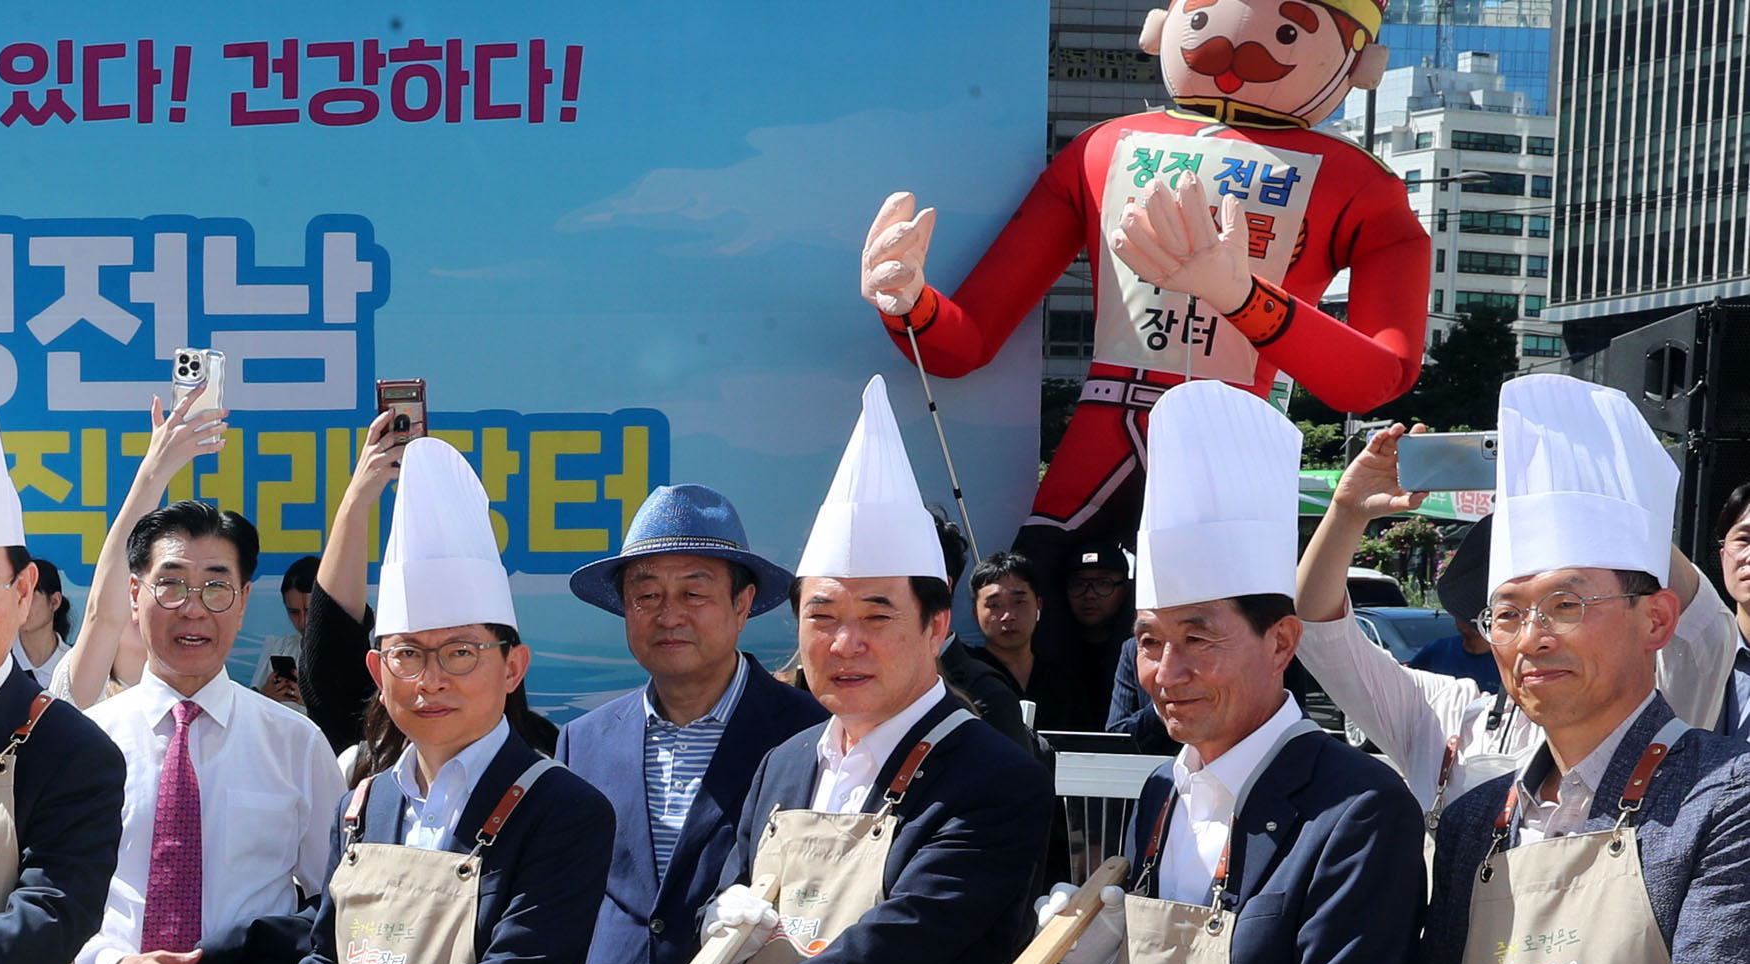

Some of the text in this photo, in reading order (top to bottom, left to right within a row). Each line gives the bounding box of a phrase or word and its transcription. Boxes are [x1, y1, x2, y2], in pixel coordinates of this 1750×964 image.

[223, 39, 584, 128] 건강하다!
[1214, 157, 1301, 207] 전남
[1140, 307, 1218, 357] 장터
[1523, 928, 1581, 954] 로컬푸드
